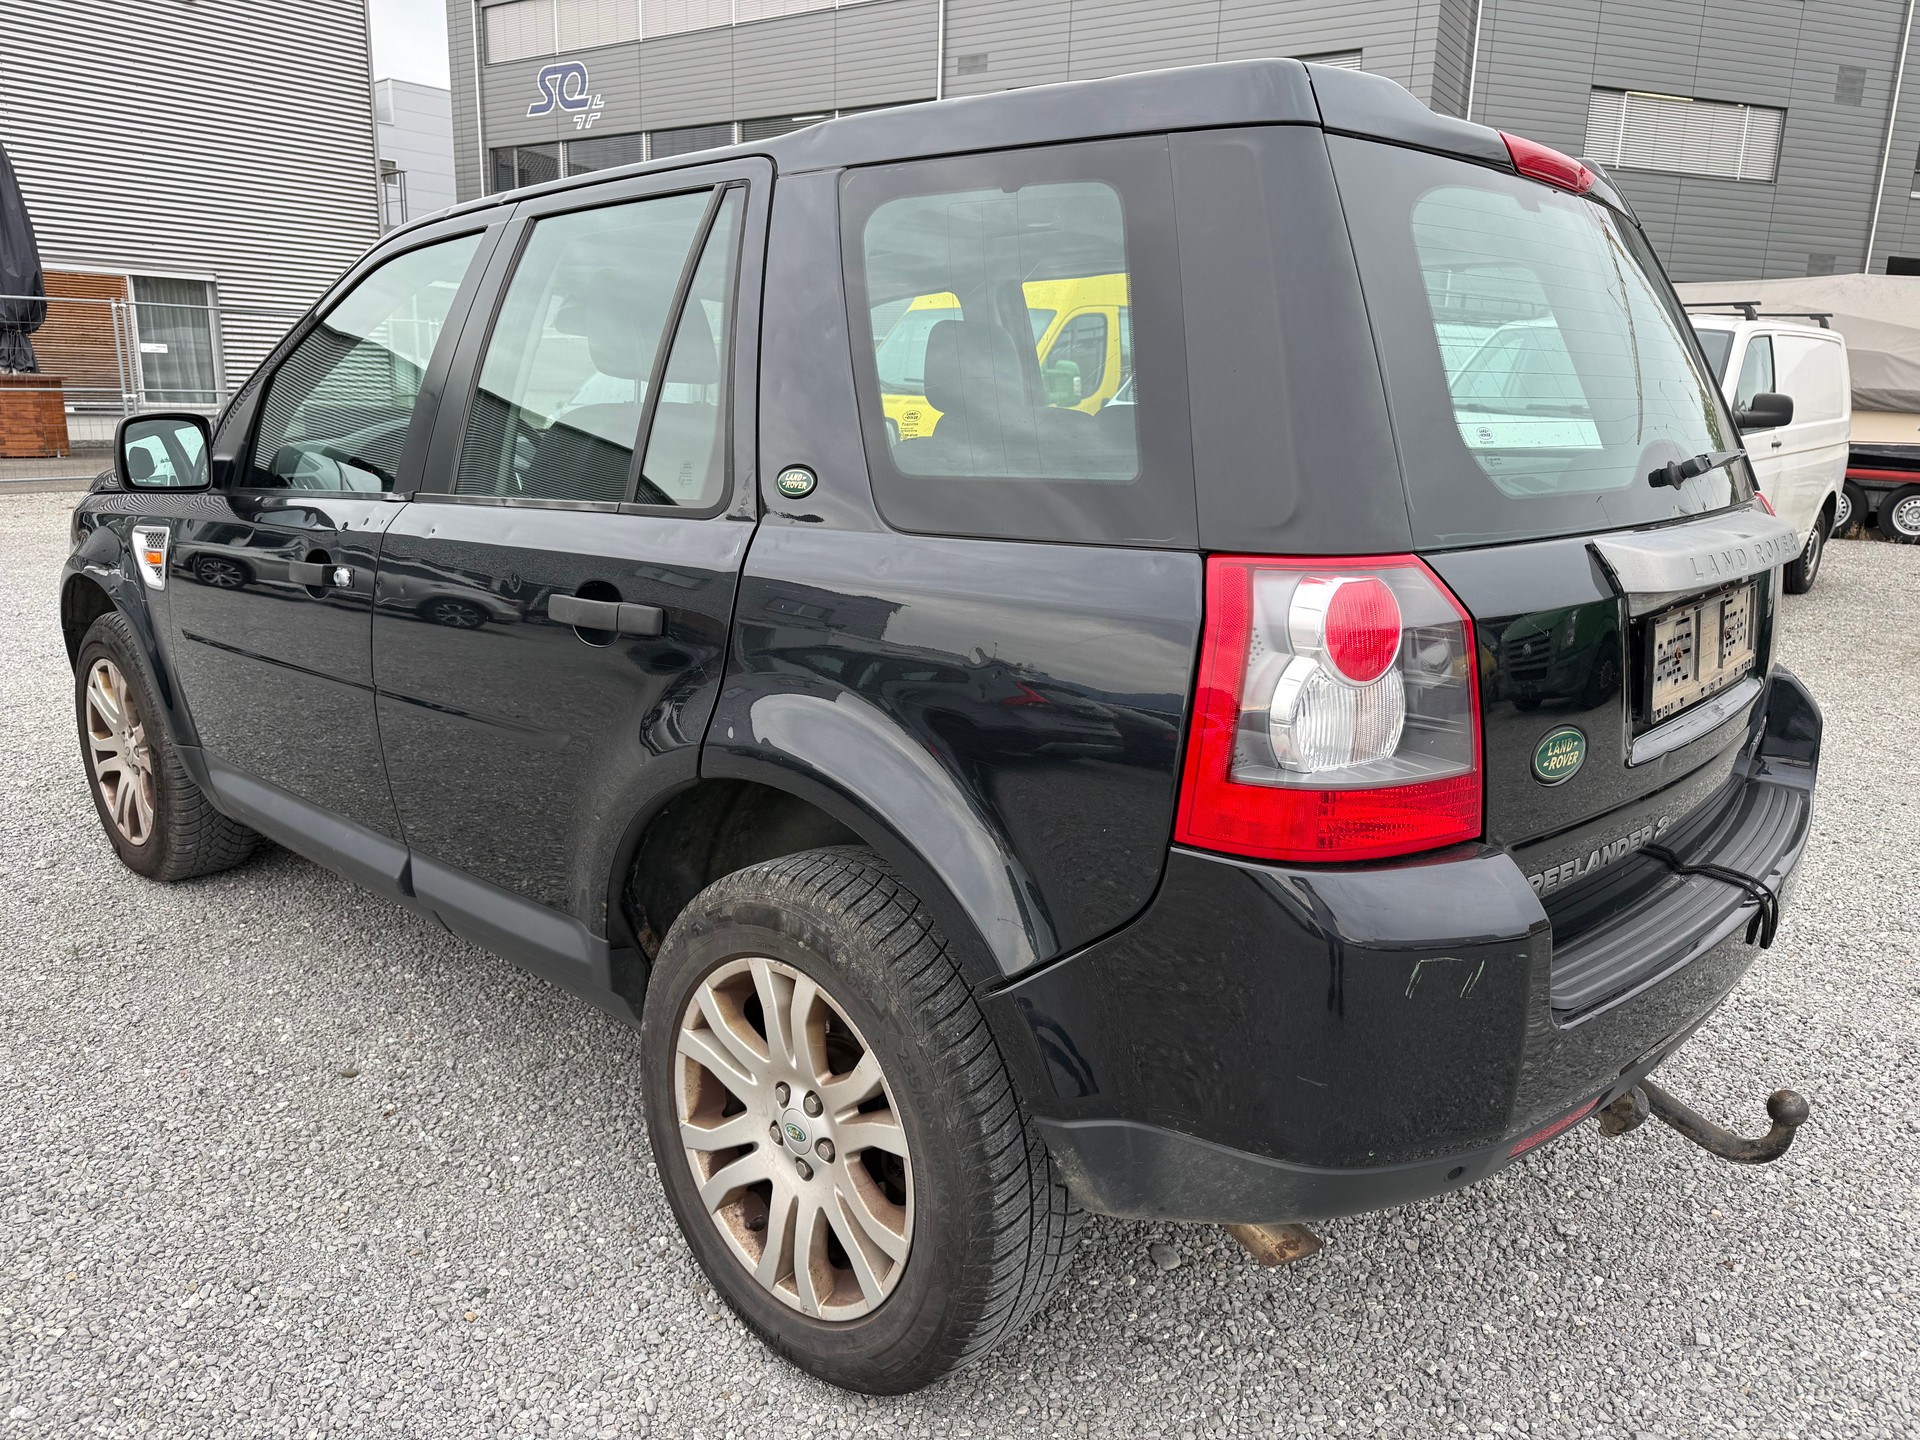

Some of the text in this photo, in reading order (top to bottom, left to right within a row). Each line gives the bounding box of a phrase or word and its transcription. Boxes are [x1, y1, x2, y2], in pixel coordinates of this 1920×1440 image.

[785, 473, 803, 481] LAND
[785, 481, 807, 489] ROVER
[1690, 532, 1798, 581] LAND ROVER
[1547, 738, 1574, 757] LAND
[1548, 751, 1579, 770] ROVER
[1527, 825, 1653, 897] REELANDER
